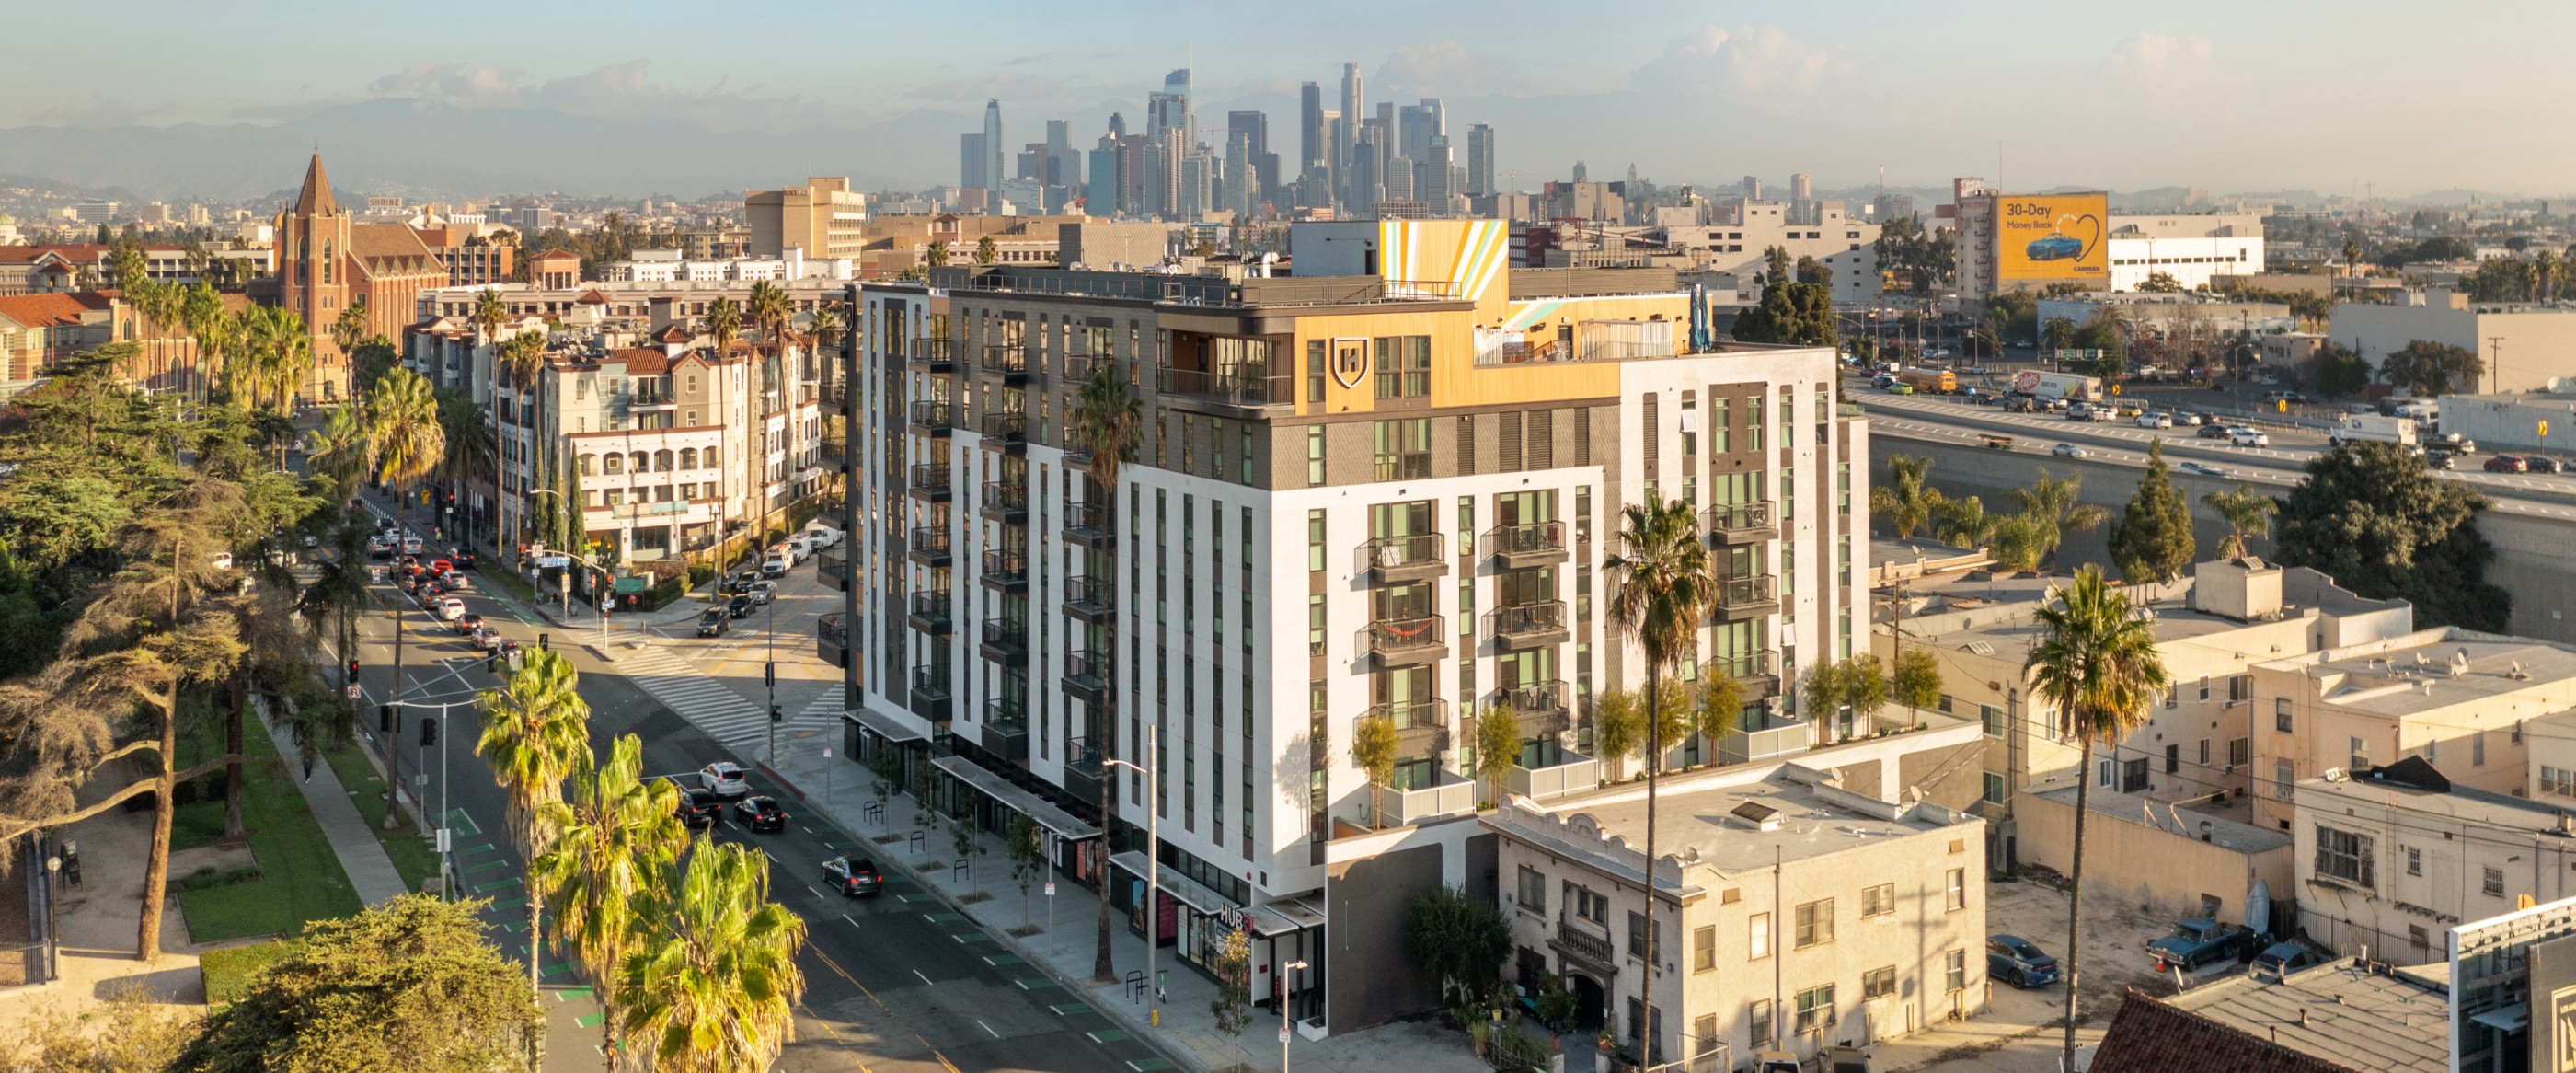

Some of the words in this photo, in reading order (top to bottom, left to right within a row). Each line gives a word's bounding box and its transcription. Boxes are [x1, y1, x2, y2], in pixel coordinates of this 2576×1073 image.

[369, 198, 400, 207] SHRINE
[2007, 203, 2052, 219] 30-Day
[2007, 221, 2032, 231] Money
[2033, 221, 2053, 229] Back
[1341, 348, 1360, 372] H
[1221, 903, 1243, 930] HUB
